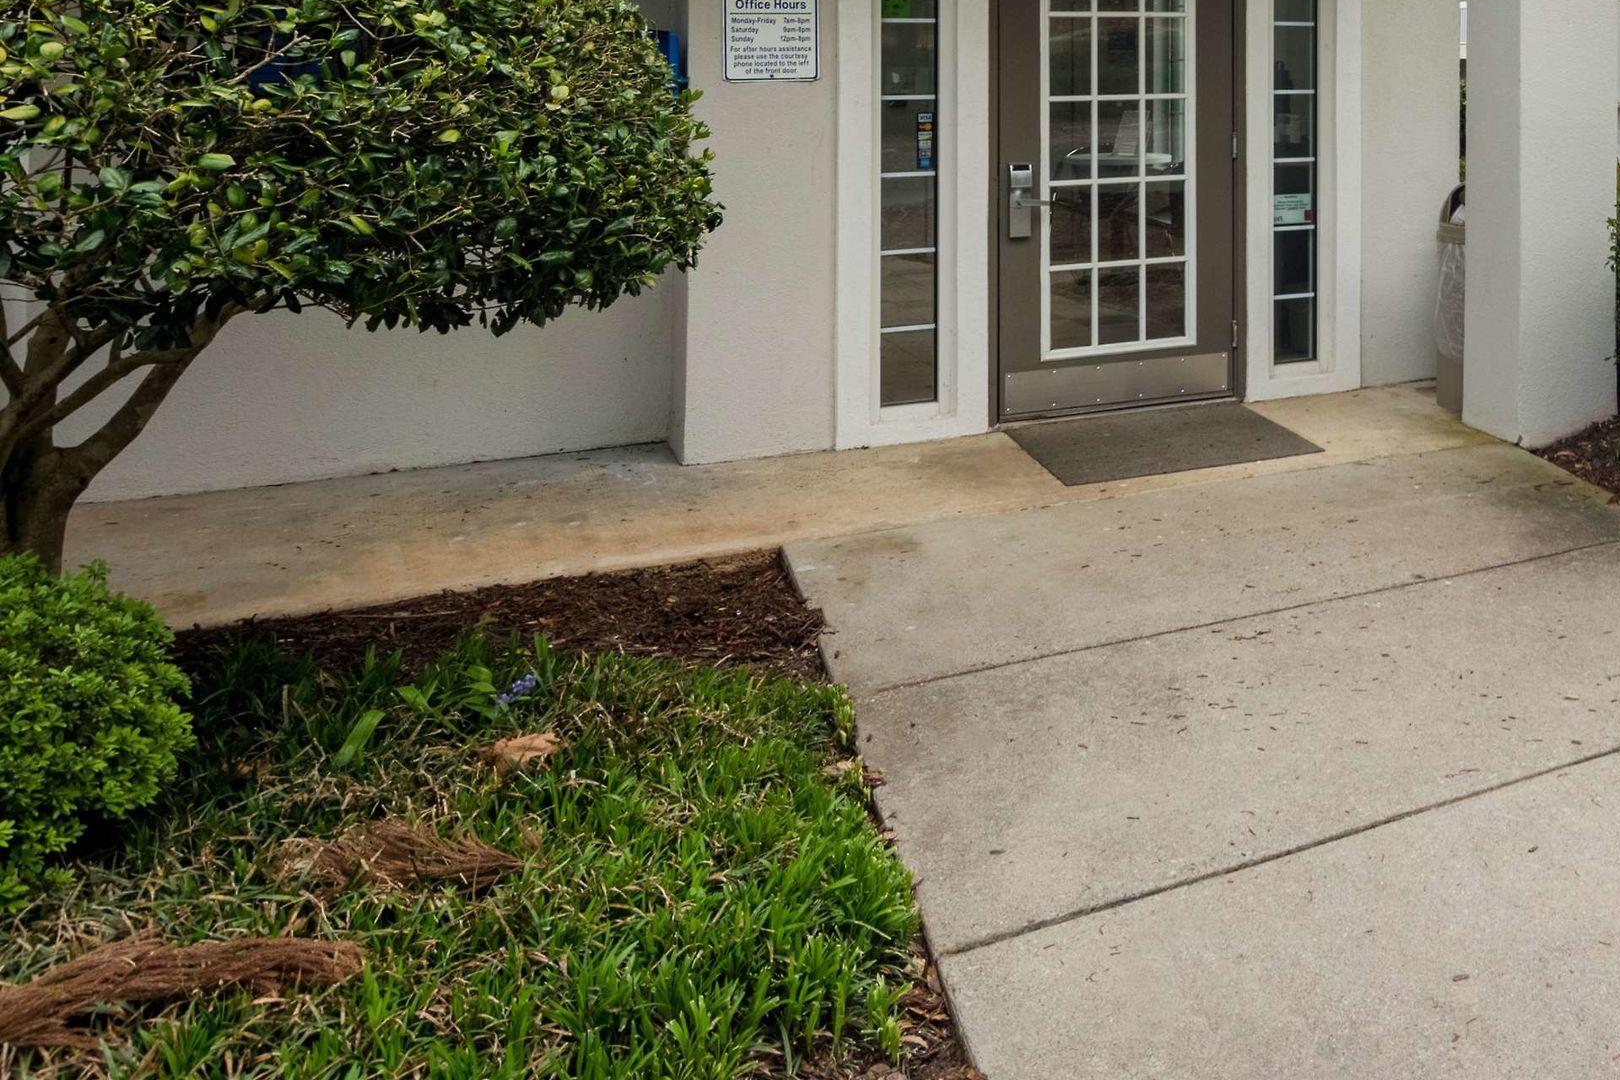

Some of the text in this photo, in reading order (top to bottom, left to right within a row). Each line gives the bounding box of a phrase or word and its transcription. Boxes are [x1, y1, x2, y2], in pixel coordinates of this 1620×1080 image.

[735, 0, 807, 9] Office Hours
[731, 17, 777, 25] Monday-Friday
[731, 26, 759, 34] Saturday
[731, 35, 754, 43] Sunday
[733, 60, 752, 68] phone
